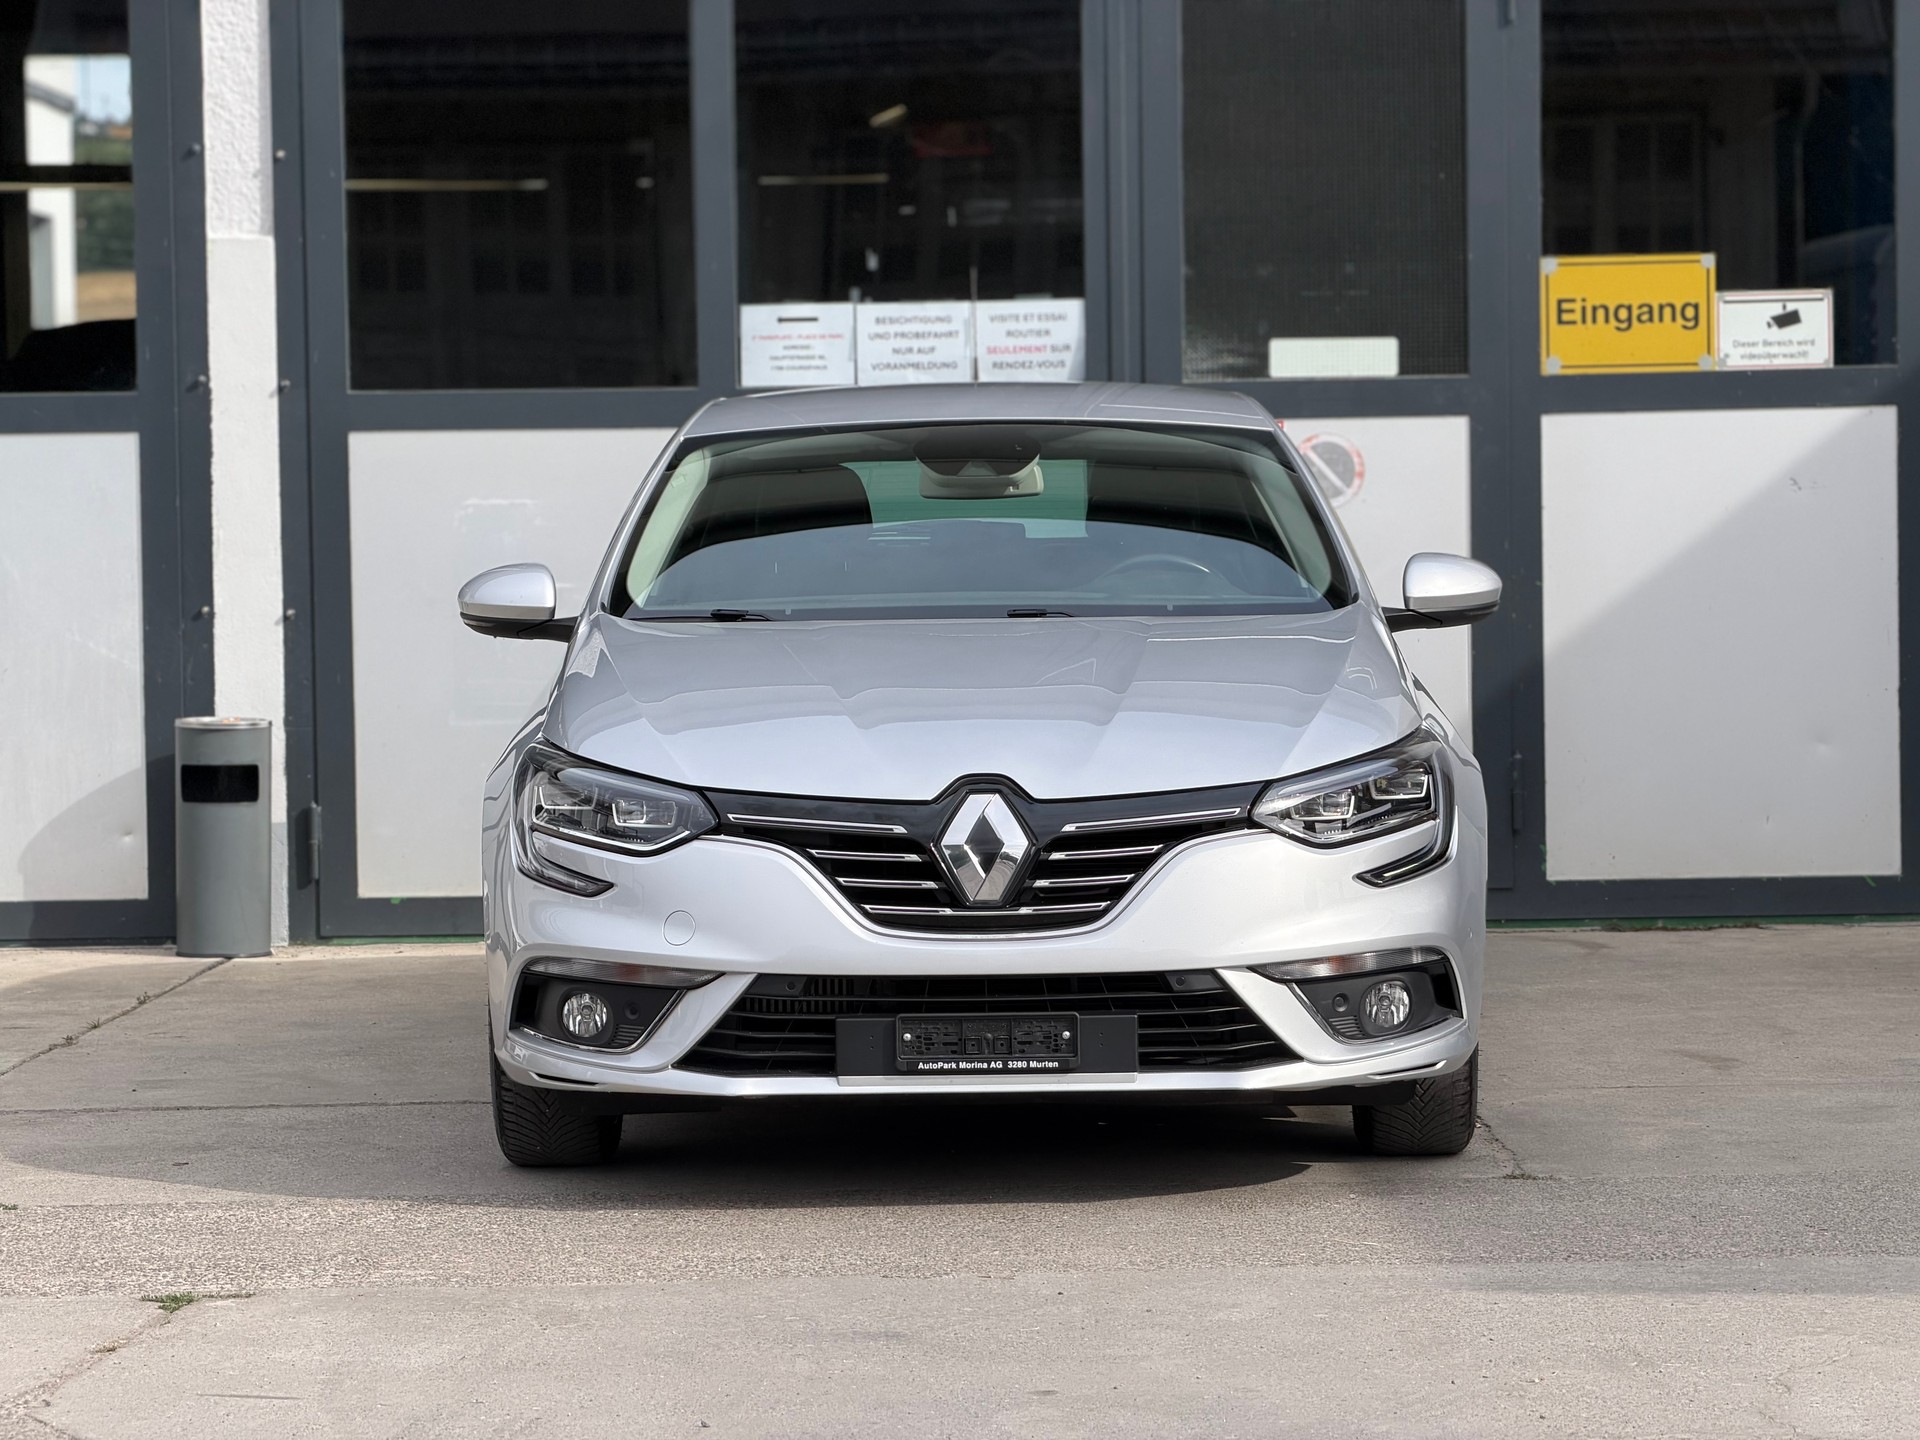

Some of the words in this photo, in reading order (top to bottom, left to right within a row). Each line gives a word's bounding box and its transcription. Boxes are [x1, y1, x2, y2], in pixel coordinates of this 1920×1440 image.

[989, 314, 1020, 323] VISITE
[1023, 313, 1035, 322] ET
[1037, 313, 1067, 321] ESSAI
[1556, 298, 1700, 332] Eingang
[875, 316, 952, 325] BESICHTIGUNG
[868, 331, 891, 340] UND
[893, 330, 959, 339] PROBEFAHRT
[1006, 329, 1051, 338] ROUTIER
[1732, 340, 1760, 348] Dieser
[1762, 339, 1794, 347] Bereich
[1796, 338, 1815, 346] wird
[892, 347, 914, 355] NUR
[917, 346, 936, 354] AUF
[987, 345, 1047, 354] SEULEMENT
[1050, 344, 1071, 353] SUR
[870, 361, 958, 371] VORANMELDUNG
[992, 360, 1066, 369] RENDEZ-VOUS
[917, 1061, 957, 1070] AutoPark
[959, 1061, 987, 1070] Morina
[989, 1061, 1003, 1069] AG
[1007, 1060, 1028, 1069] 3280
[1029, 1060, 1059, 1068] Murten
